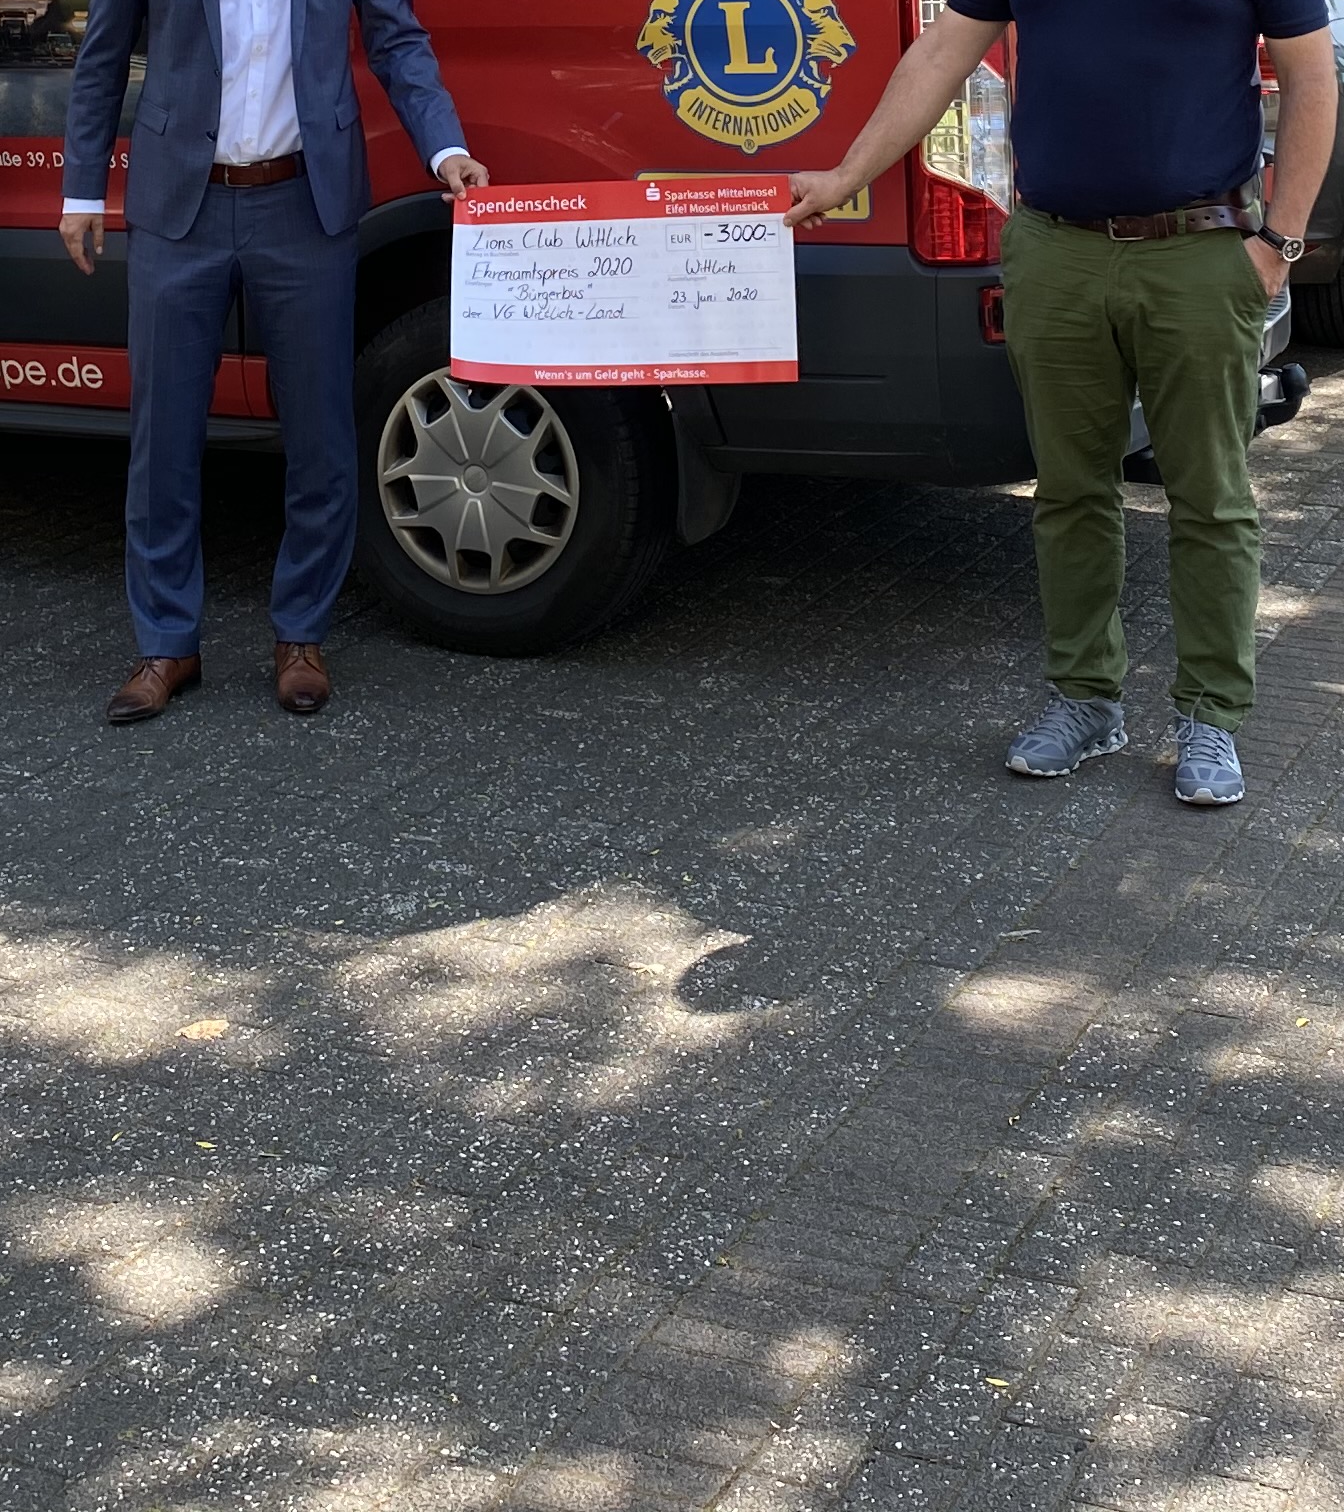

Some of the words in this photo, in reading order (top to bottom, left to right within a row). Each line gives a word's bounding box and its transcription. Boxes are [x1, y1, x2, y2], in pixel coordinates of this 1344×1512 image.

[718, 1, 777, 74] L
[687, 96, 810, 137] INTERNATIONAL
[665, 190, 714, 202] Sparkasse
[717, 186, 777, 199] Mittelmosel
[468, 195, 587, 217] Spendenscheck
[665, 204, 687, 214] Eifel
[690, 202, 719, 213] Mosel
[721, 201, 769, 212] Hunsrück
[472, 230, 513, 251] Lions
[523, 228, 563, 249] Club
[575, 226, 639, 248] Wittlich
[670, 234, 691, 244] EUR
[472, 261, 579, 286] Ehrenamtspreis
[588, 257, 633, 277] 2020
[685, 258, 737, 275] Wittlich
[727, 287, 758, 301] 2020
[462, 306, 481, 318] der
[493, 303, 516, 319] VG
[534, 370, 573, 380] Wenn's
[575, 371, 592, 380] um
[594, 369, 618, 380] Geld
[621, 369, 644, 382] geht
